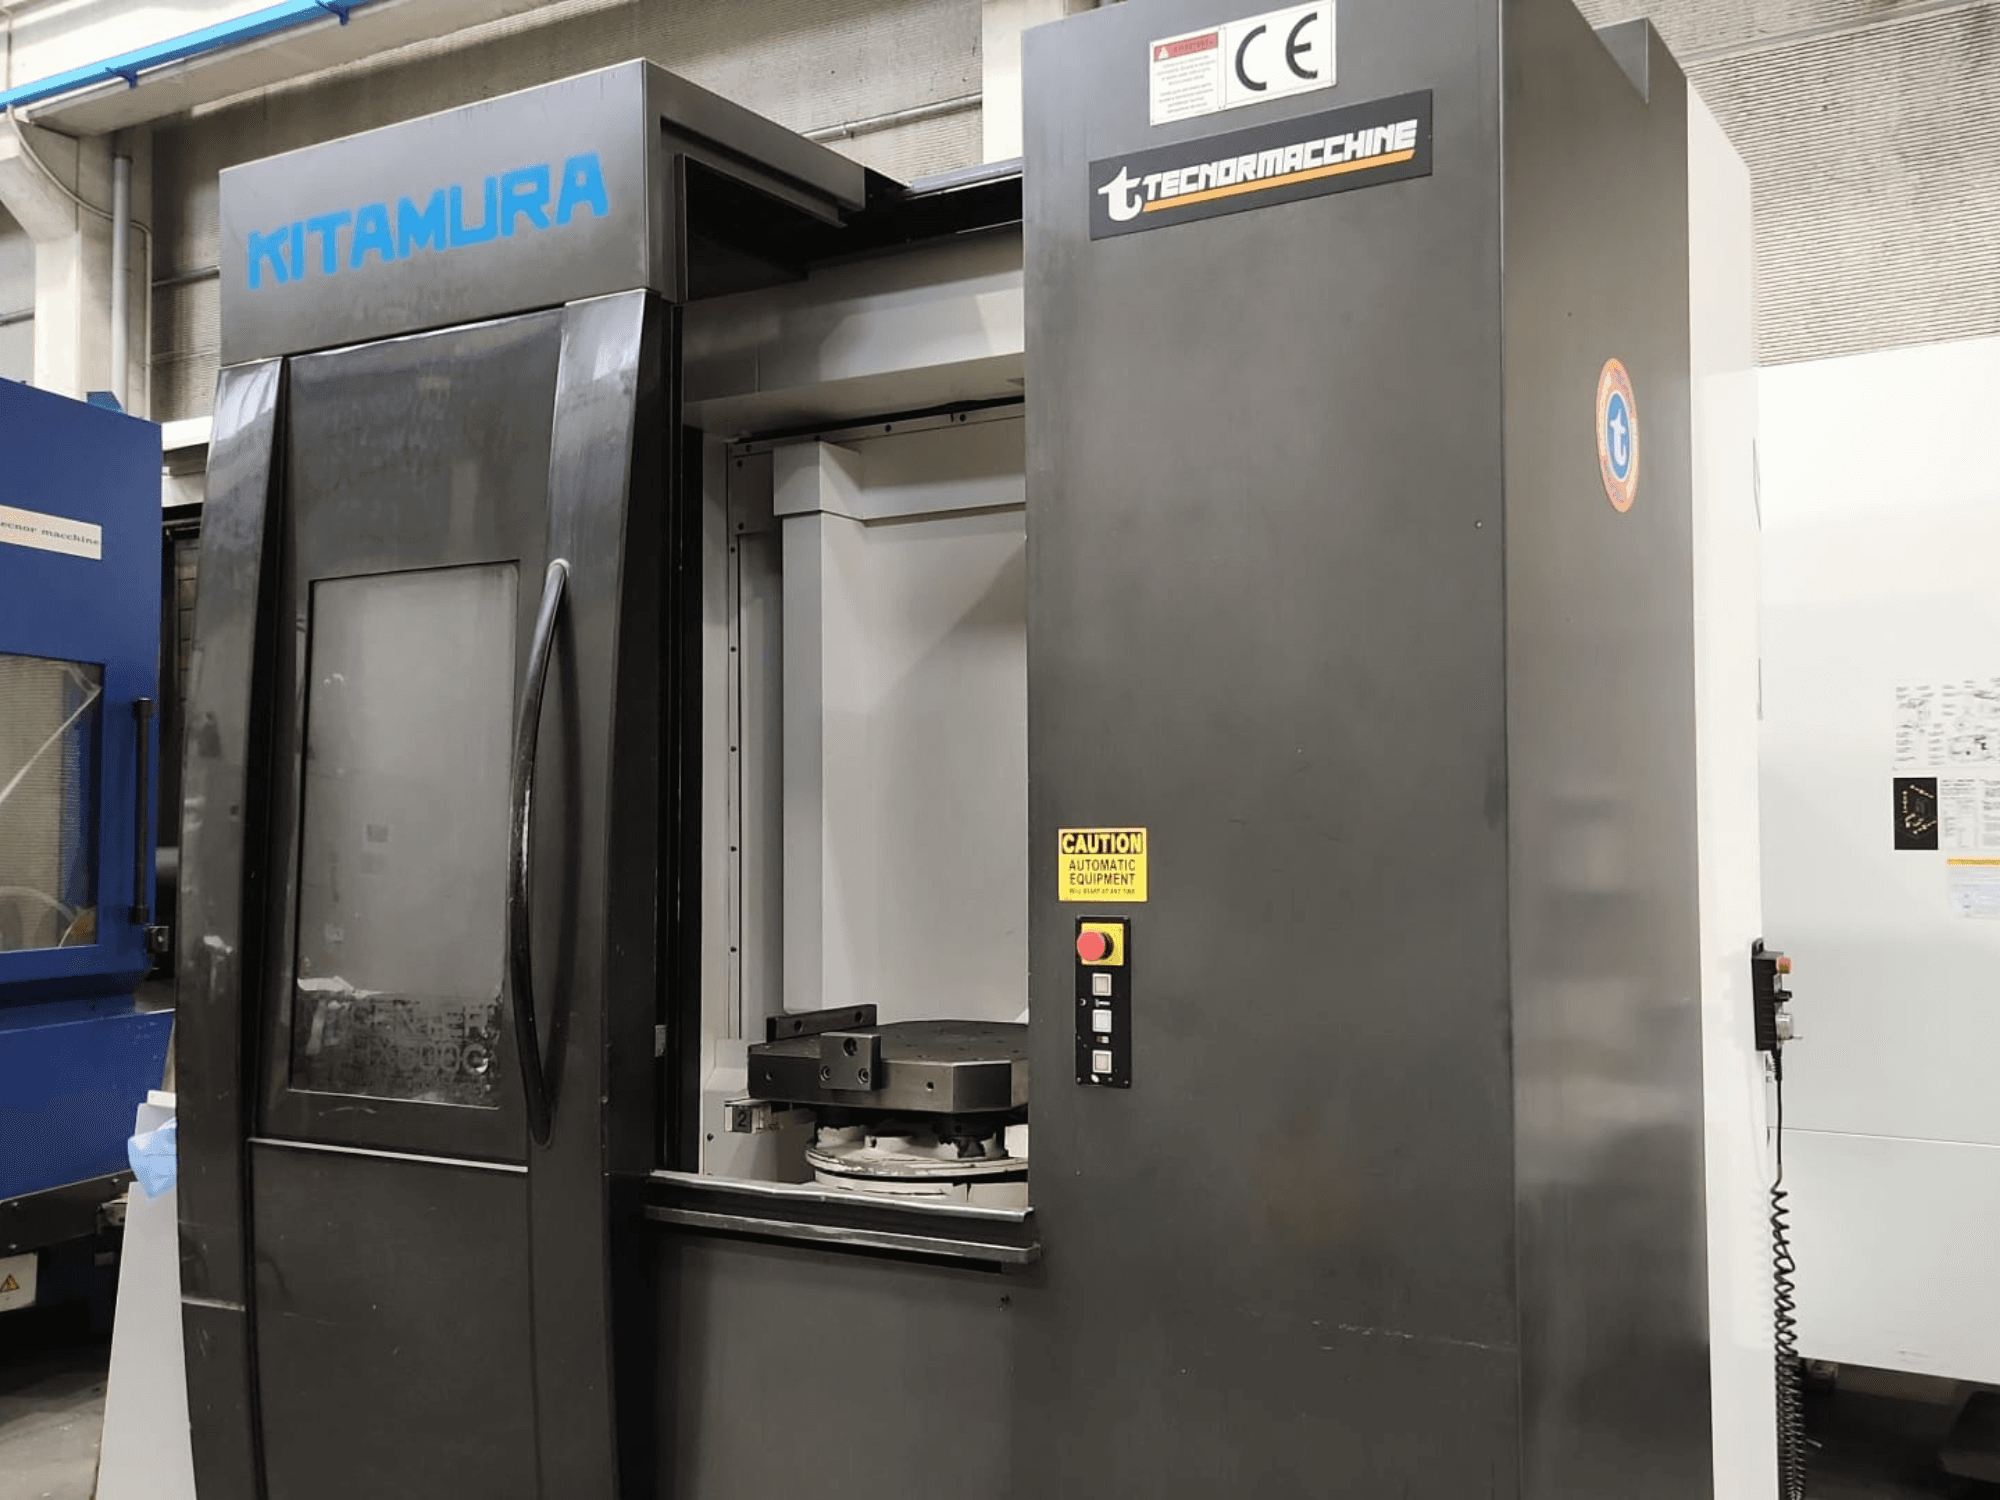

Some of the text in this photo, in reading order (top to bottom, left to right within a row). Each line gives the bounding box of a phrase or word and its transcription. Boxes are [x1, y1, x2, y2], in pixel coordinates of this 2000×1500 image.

[1142, 119, 1418, 201] TECNORMACCHINE
[246, 152, 609, 290] KITAMURA
[41, 529, 99, 544] macchine
[1062, 833, 1142, 854] CAUTION
[1069, 859, 1136, 872] AUTOMATIC
[1069, 873, 1136, 886] EQUIPMENT
[738, 1110, 747, 1127] 2
